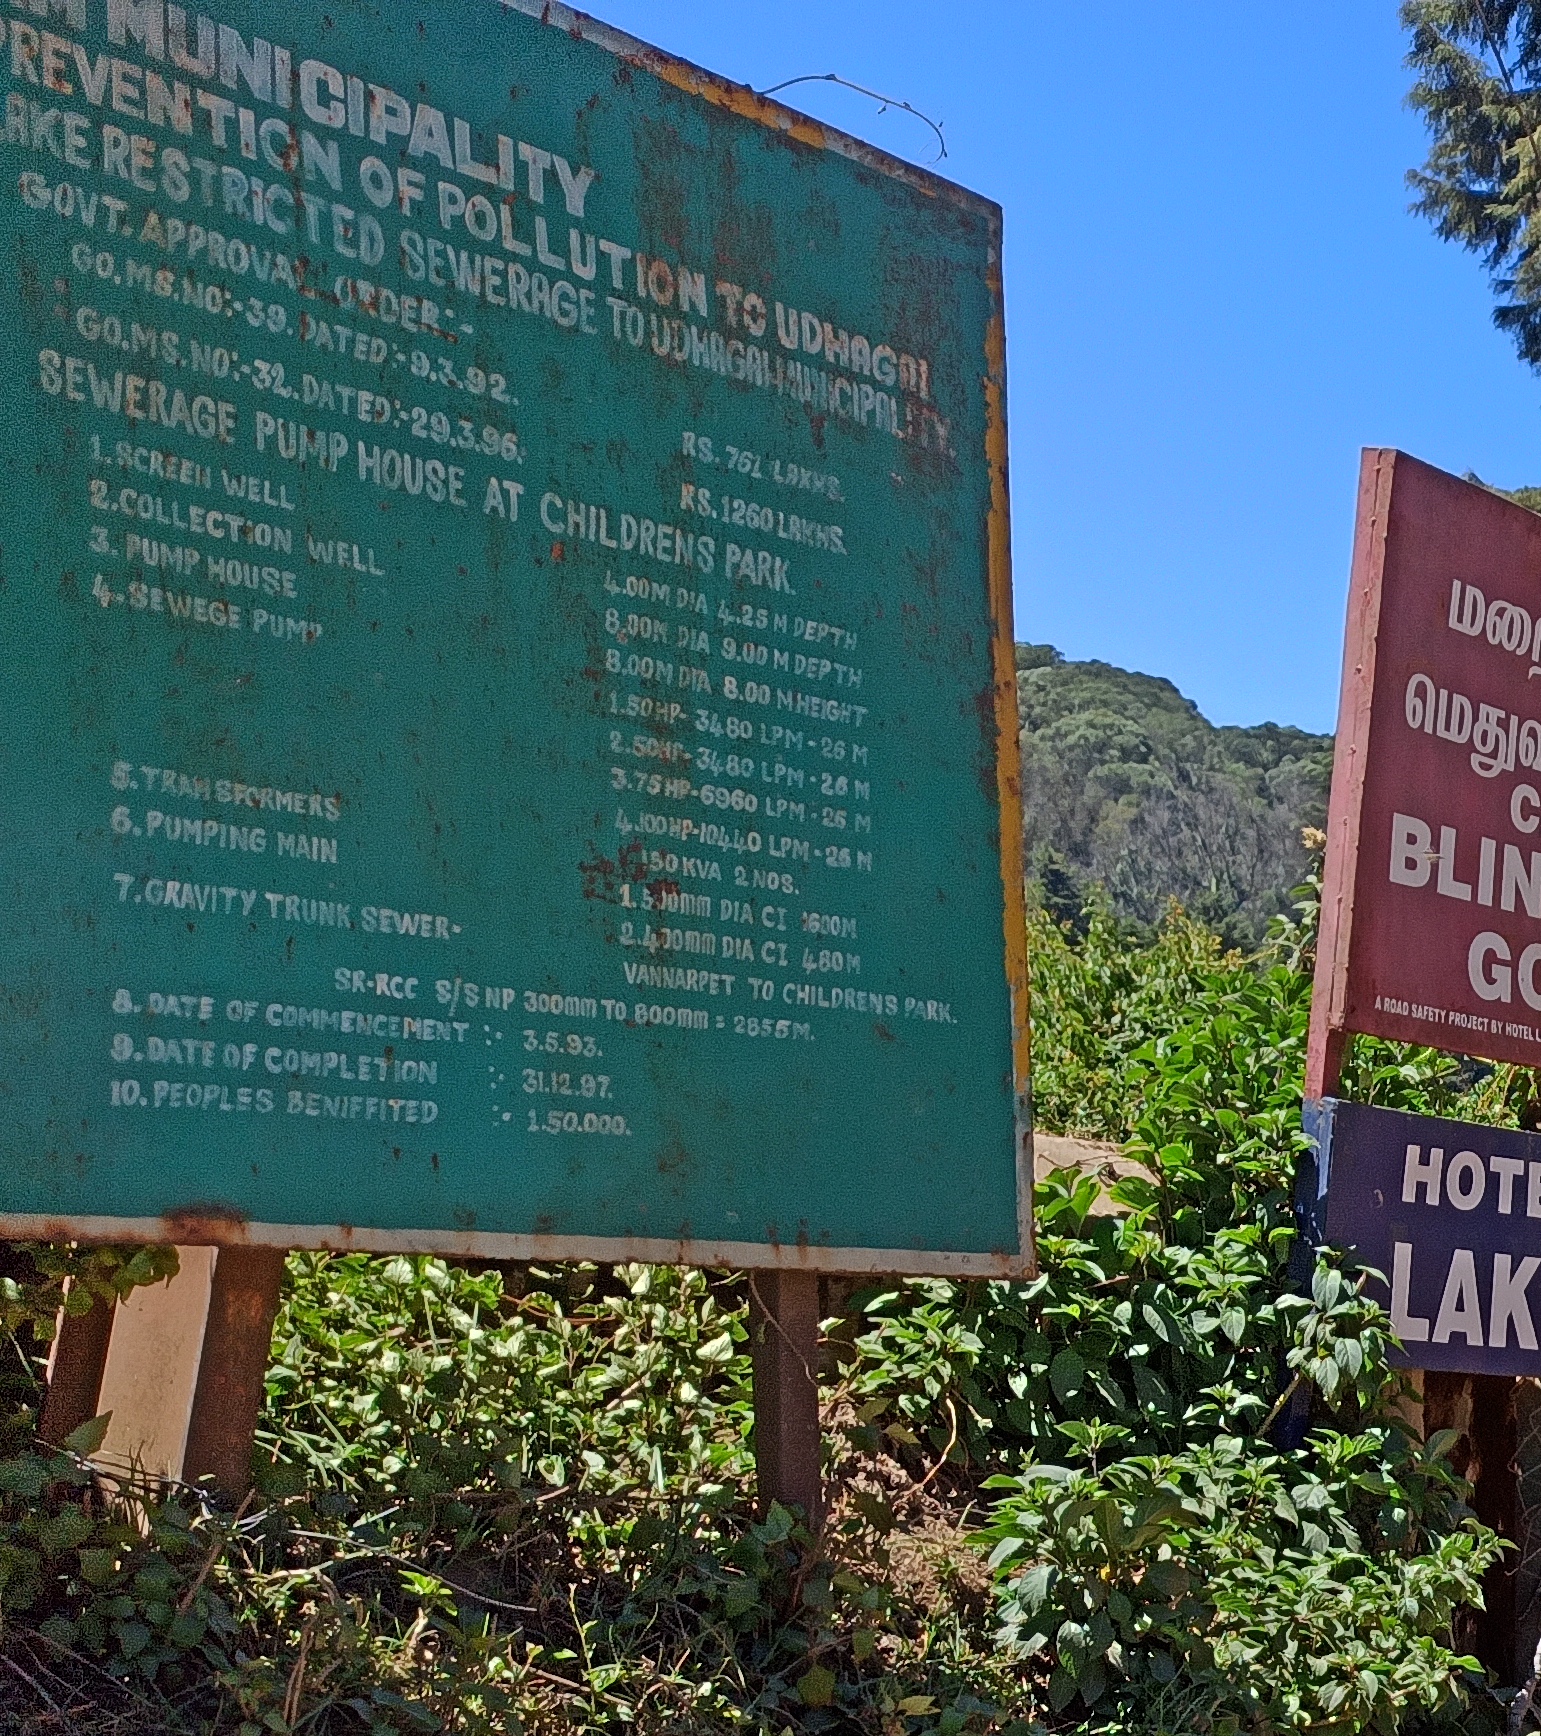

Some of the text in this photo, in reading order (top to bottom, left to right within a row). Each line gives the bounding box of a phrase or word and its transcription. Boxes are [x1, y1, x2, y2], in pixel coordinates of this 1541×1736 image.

[107, 0, 596, 218] MUNICIPALITY
[0, 17, 343, 192] REVENTION
[359, 155, 426, 218] OF
[438, 180, 708, 319] POLLUTION
[714, 279, 768, 337] TO
[0, 91, 93, 170] AKE
[101, 123, 385, 267] RESTRICTED
[400, 228, 598, 337] SEWERAGE
[606, 297, 645, 347] TO
[17, 170, 135, 237] GOVT.
[38, 348, 237, 446] SEWERAGE
[254, 409, 349, 473] PUMP
[357, 440, 468, 507] HOUSE
[483, 476, 525, 522] AT
[540, 491, 716, 575] CHILDRENS
[221, 467, 295, 512] WELL
[126, 533, 200, 576] PUMP
[208, 555, 298, 600] HOUSE
[307, 533, 386, 576] WELL
[253, 607, 323, 645] PUMP
[676, 586, 709, 615] DIA
[793, 616, 858, 651] DEPTH
[676, 624, 710, 656] DIA
[794, 652, 863, 689] DEPTH
[276, 830, 339, 864] MAIN
[265, 890, 352, 929] TRUNK
[719, 898, 755, 925] DIA
[721, 935, 755, 963] DIA
[601, 998, 628, 1022] TO
[622, 960, 736, 996] VANNARPET
[748, 976, 775, 1002] TO
[782, 982, 899, 1017] CHILDRENS
[226, 999, 259, 1023] OF
[265, 1002, 471, 1043] COMMENCEMENT
[1374, 994, 1382, 1011] A
[1383, 997, 1410, 1017] ROAD
[1411, 1002, 1448, 1025] SAFETY
[1448, 1011, 1490, 1033] PROJECT
[1490, 1018, 1505, 1035] BY
[1505, 1021, 1535, 1042] HOTEL
[224, 1041, 259, 1071] OF
[264, 1046, 439, 1085] COMPLETION
